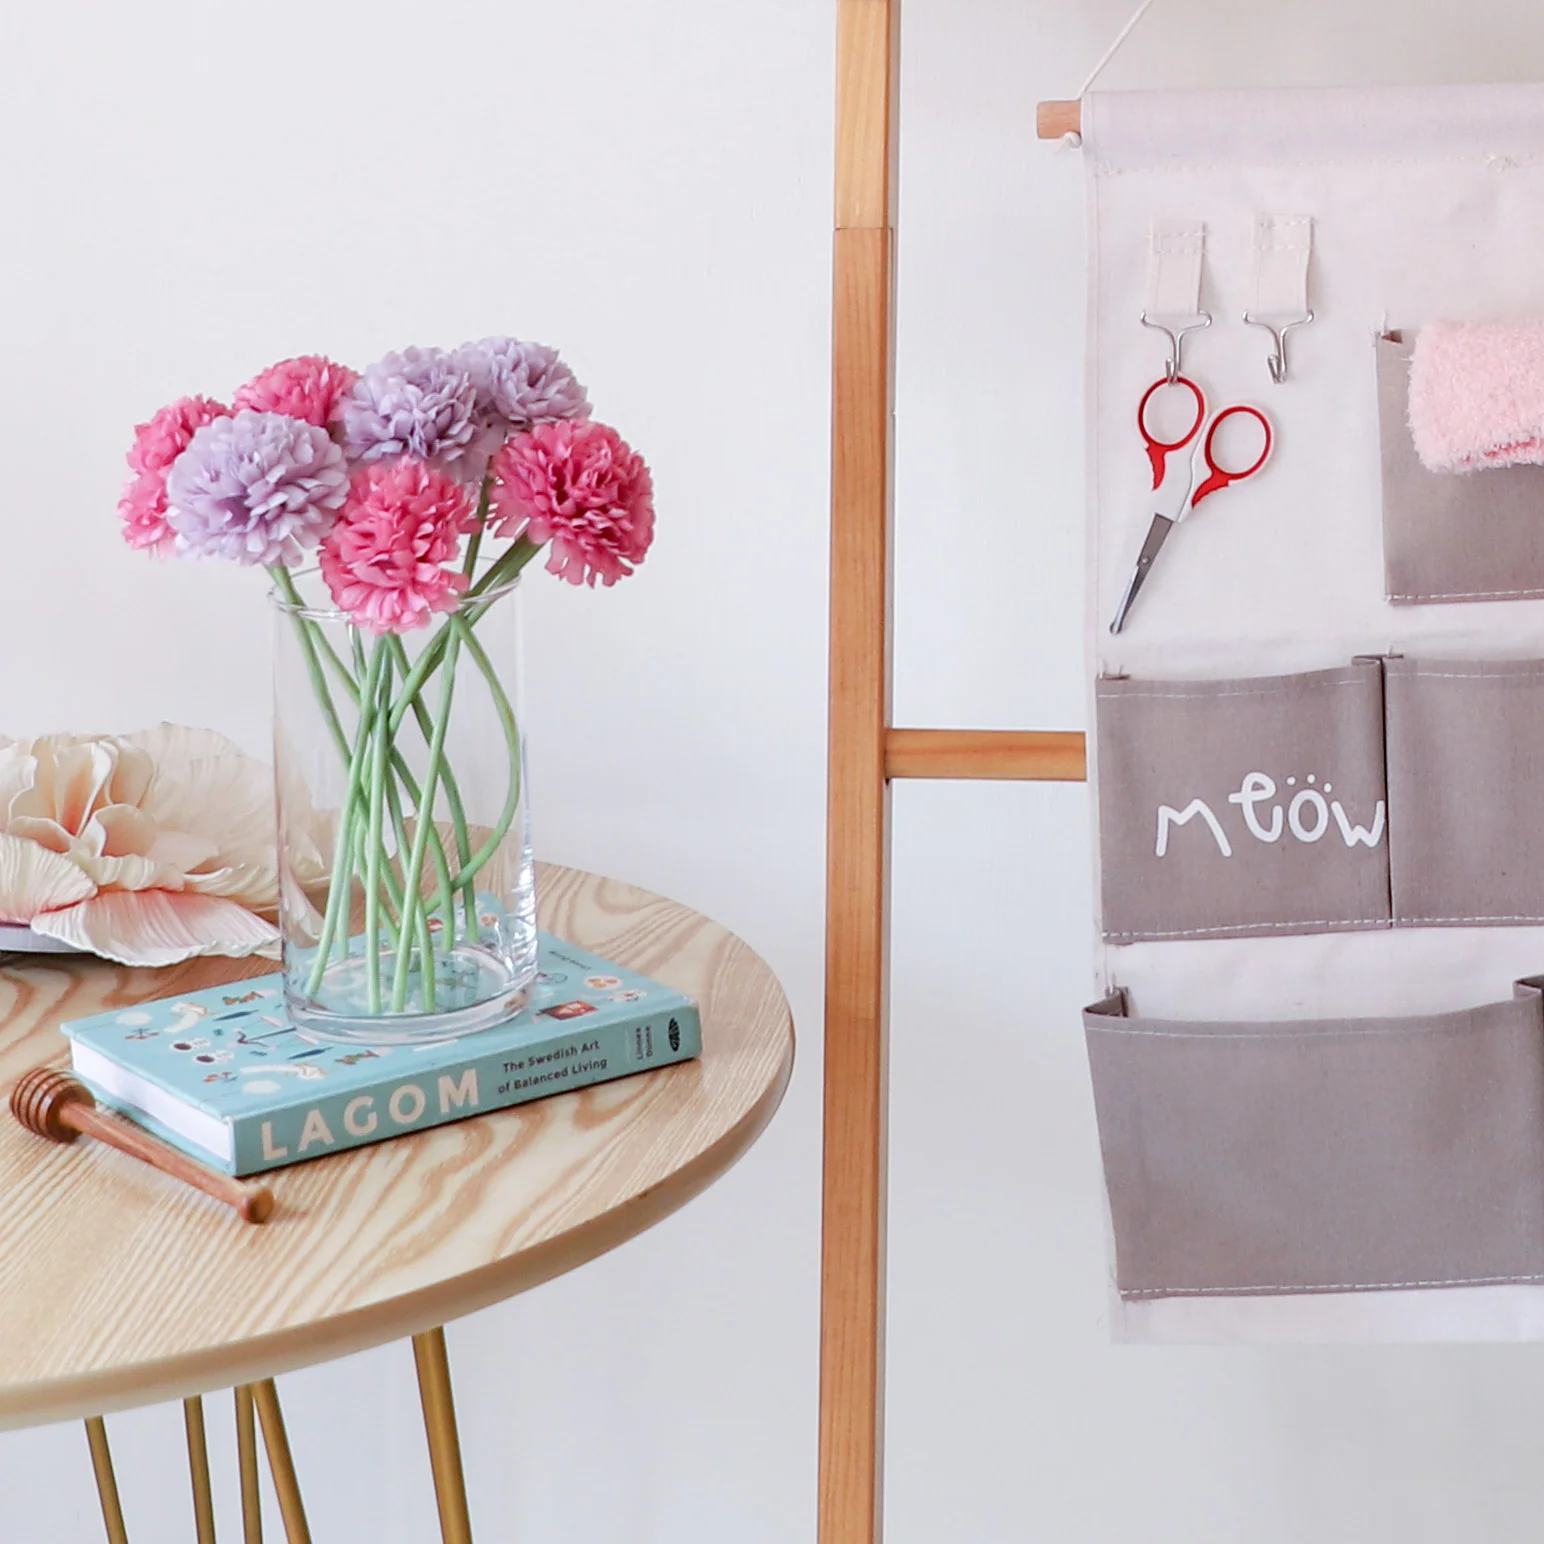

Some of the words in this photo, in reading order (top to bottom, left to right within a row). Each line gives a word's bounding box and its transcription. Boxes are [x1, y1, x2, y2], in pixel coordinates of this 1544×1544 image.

[503, 1060, 525, 1073] The
[528, 1047, 578, 1066] Swedish
[581, 1040, 600, 1054] Art
[498, 1083, 510, 1095] of
[514, 1066, 569, 1089] Balanced
[572, 1058, 607, 1073] Living
[261, 1068, 479, 1161] LAGOM
